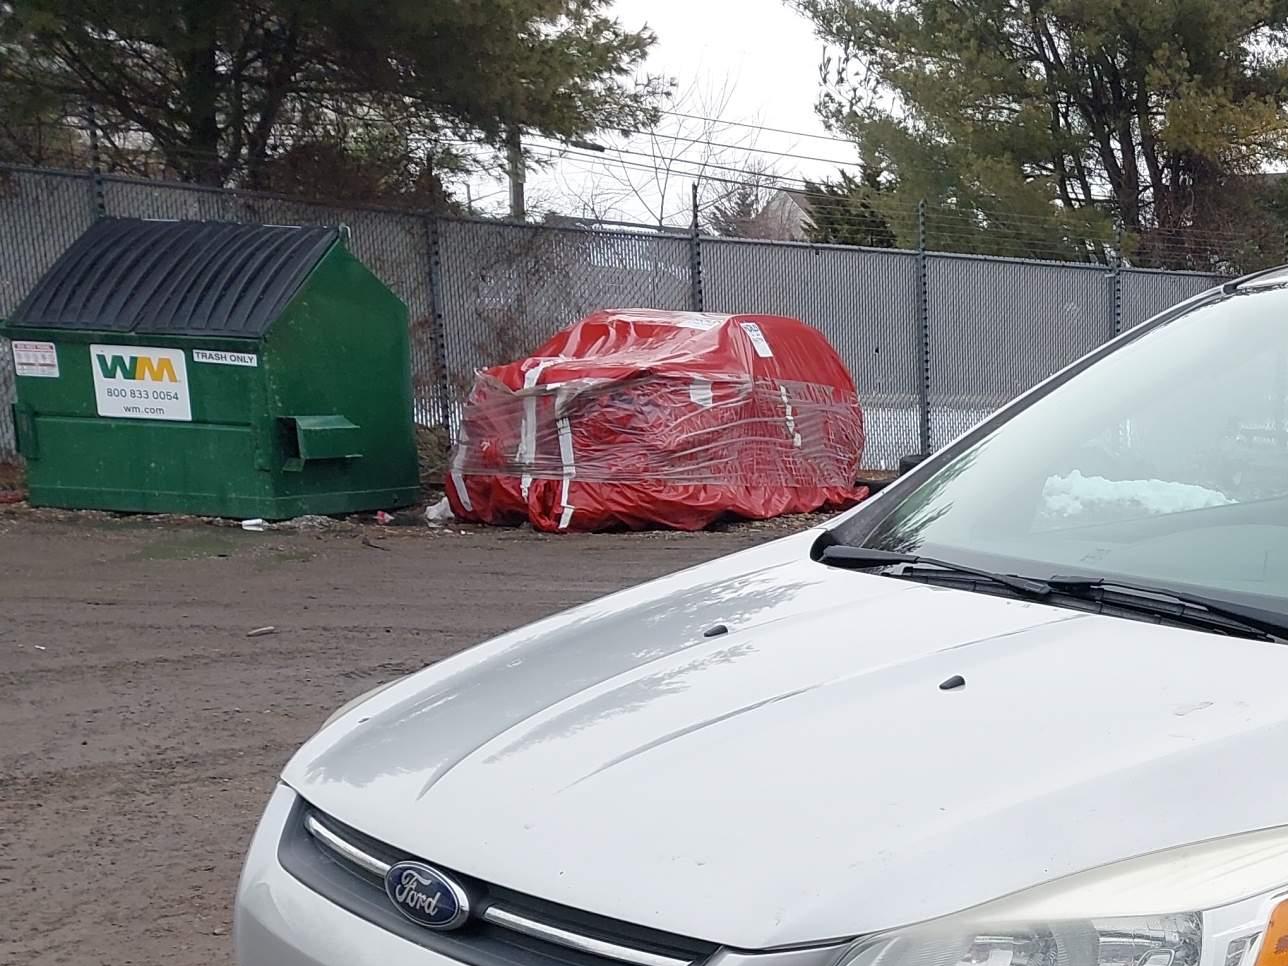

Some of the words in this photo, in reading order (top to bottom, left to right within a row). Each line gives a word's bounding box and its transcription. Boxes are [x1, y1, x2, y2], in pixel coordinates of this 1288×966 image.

[194, 351, 227, 361] TRASH
[229, 354, 255, 364] ONLY
[96, 353, 178, 383] WM
[106, 387, 127, 398] 800
[129, 388, 150, 400] 833
[152, 390, 179, 401] 0054
[123, 405, 165, 415] wm.com
[395, 869, 441, 916] Ford
